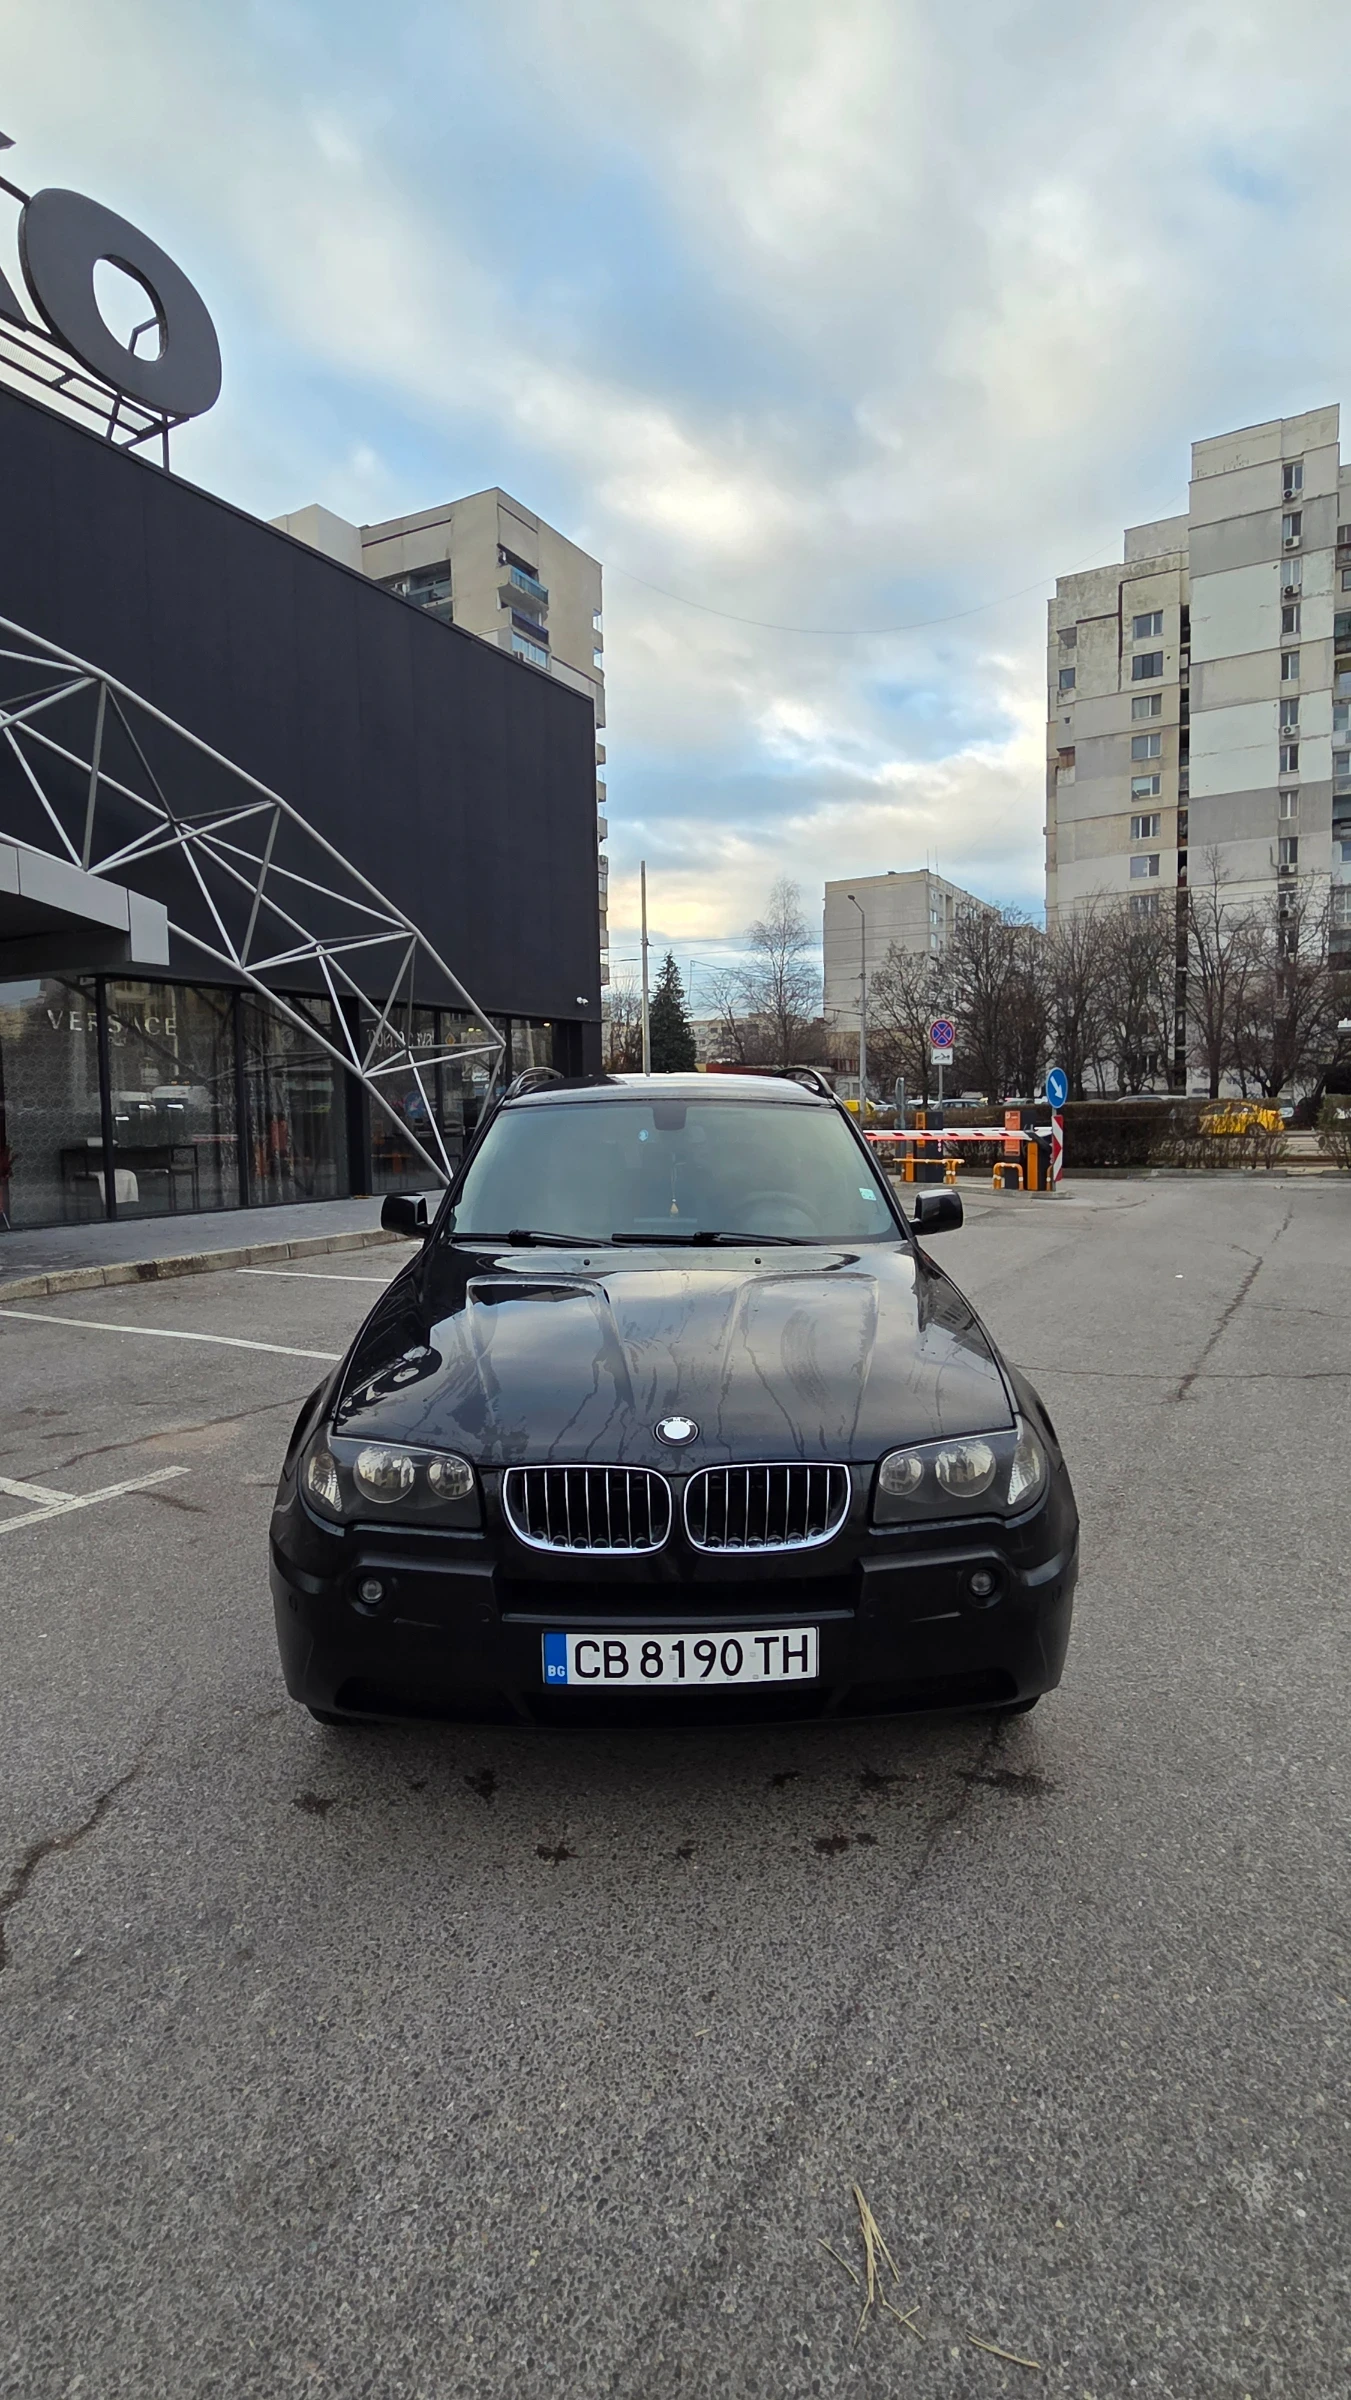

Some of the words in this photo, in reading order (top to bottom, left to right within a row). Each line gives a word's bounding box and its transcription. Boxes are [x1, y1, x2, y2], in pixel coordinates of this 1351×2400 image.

[574, 1640, 629, 1679] CB
[640, 1638, 743, 1678] 8190
[754, 1634, 808, 1675] TH
[547, 1665, 566, 1677] BG
